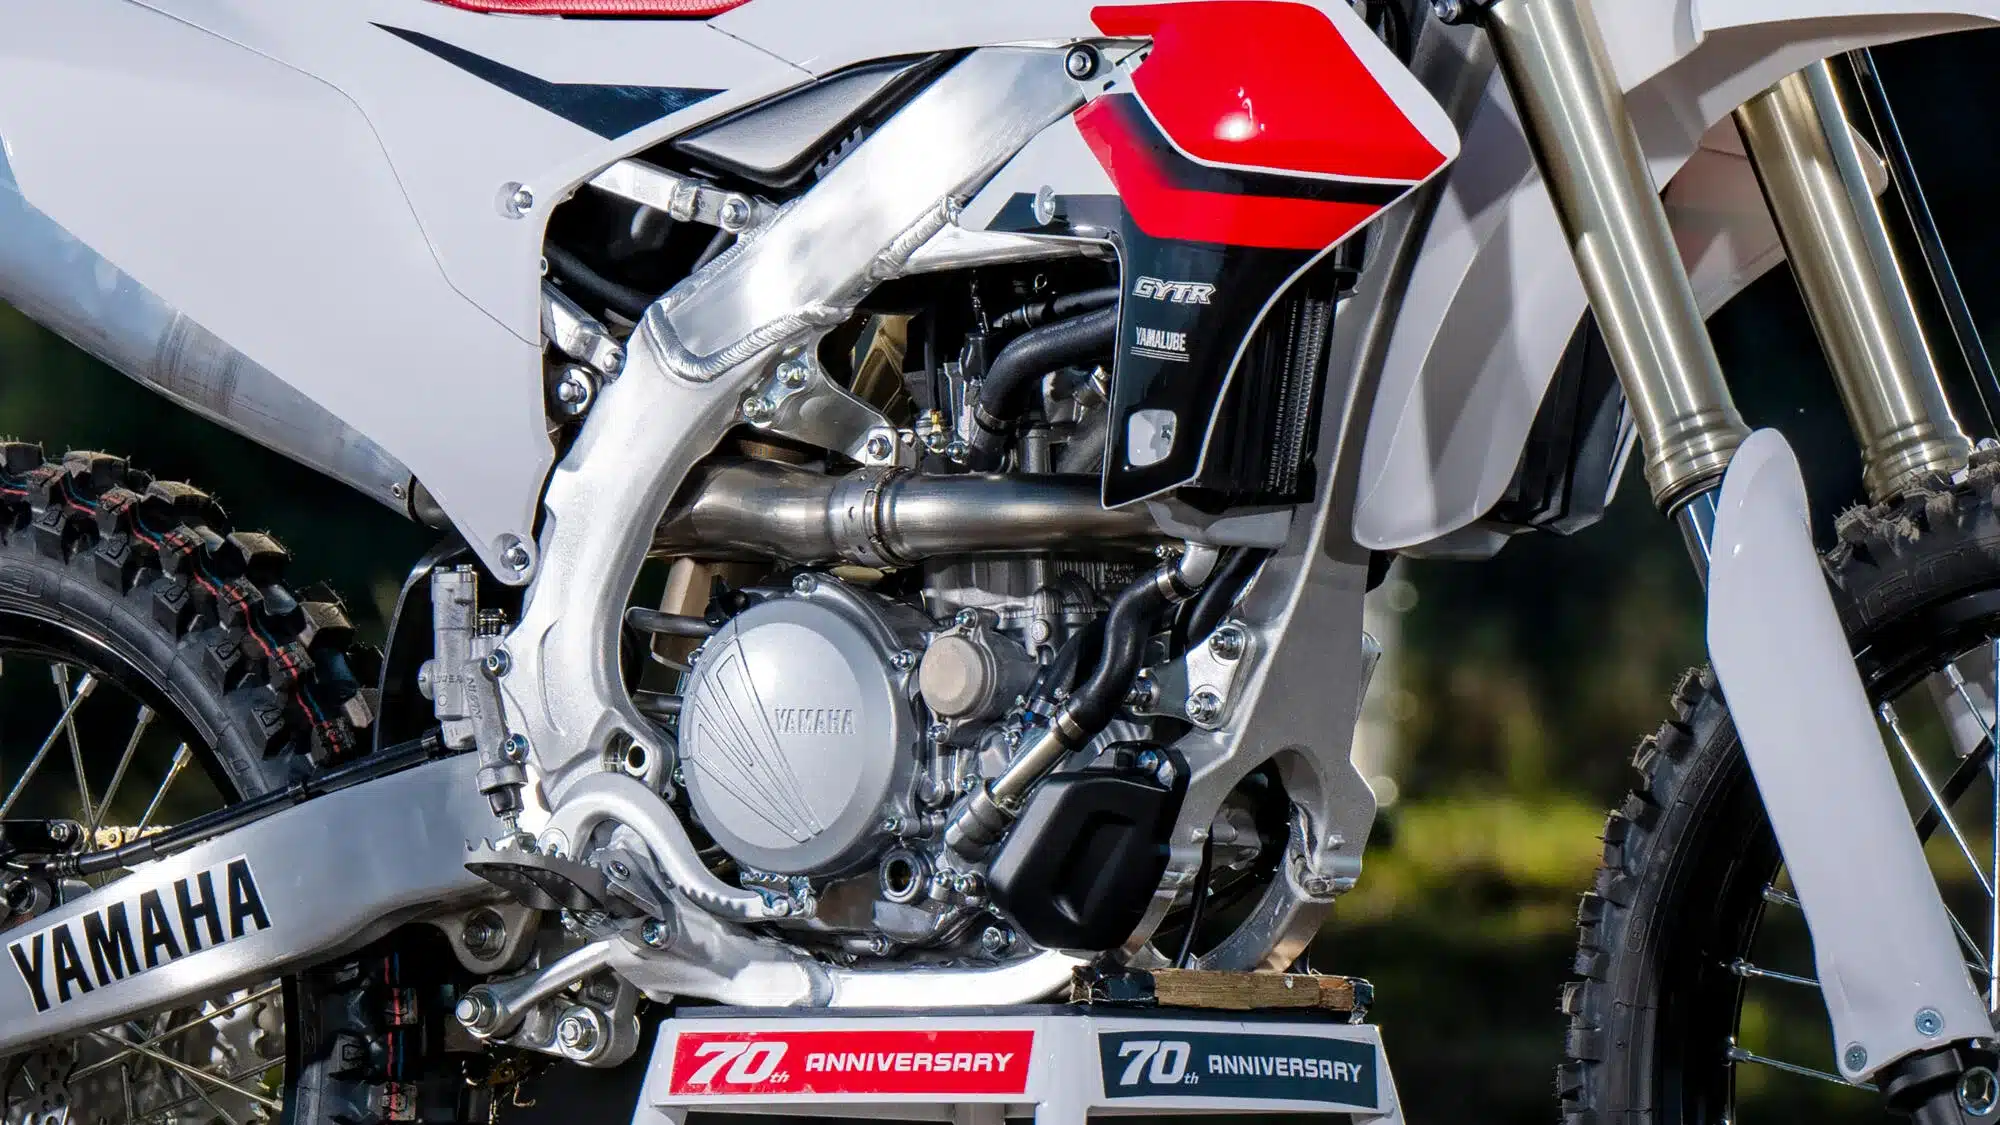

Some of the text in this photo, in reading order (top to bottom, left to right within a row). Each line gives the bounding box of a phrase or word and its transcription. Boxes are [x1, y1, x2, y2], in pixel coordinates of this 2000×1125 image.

[1132, 276, 1216, 304] GYTR
[1136, 327, 1187, 352] YAMALUBE
[775, 708, 856, 734] YAMAHA
[9, 858, 271, 1012] YAMAHA
[806, 1053, 1014, 1073] ANNIVERSARY
[1208, 1054, 1362, 1083] ANNIVERSARY
